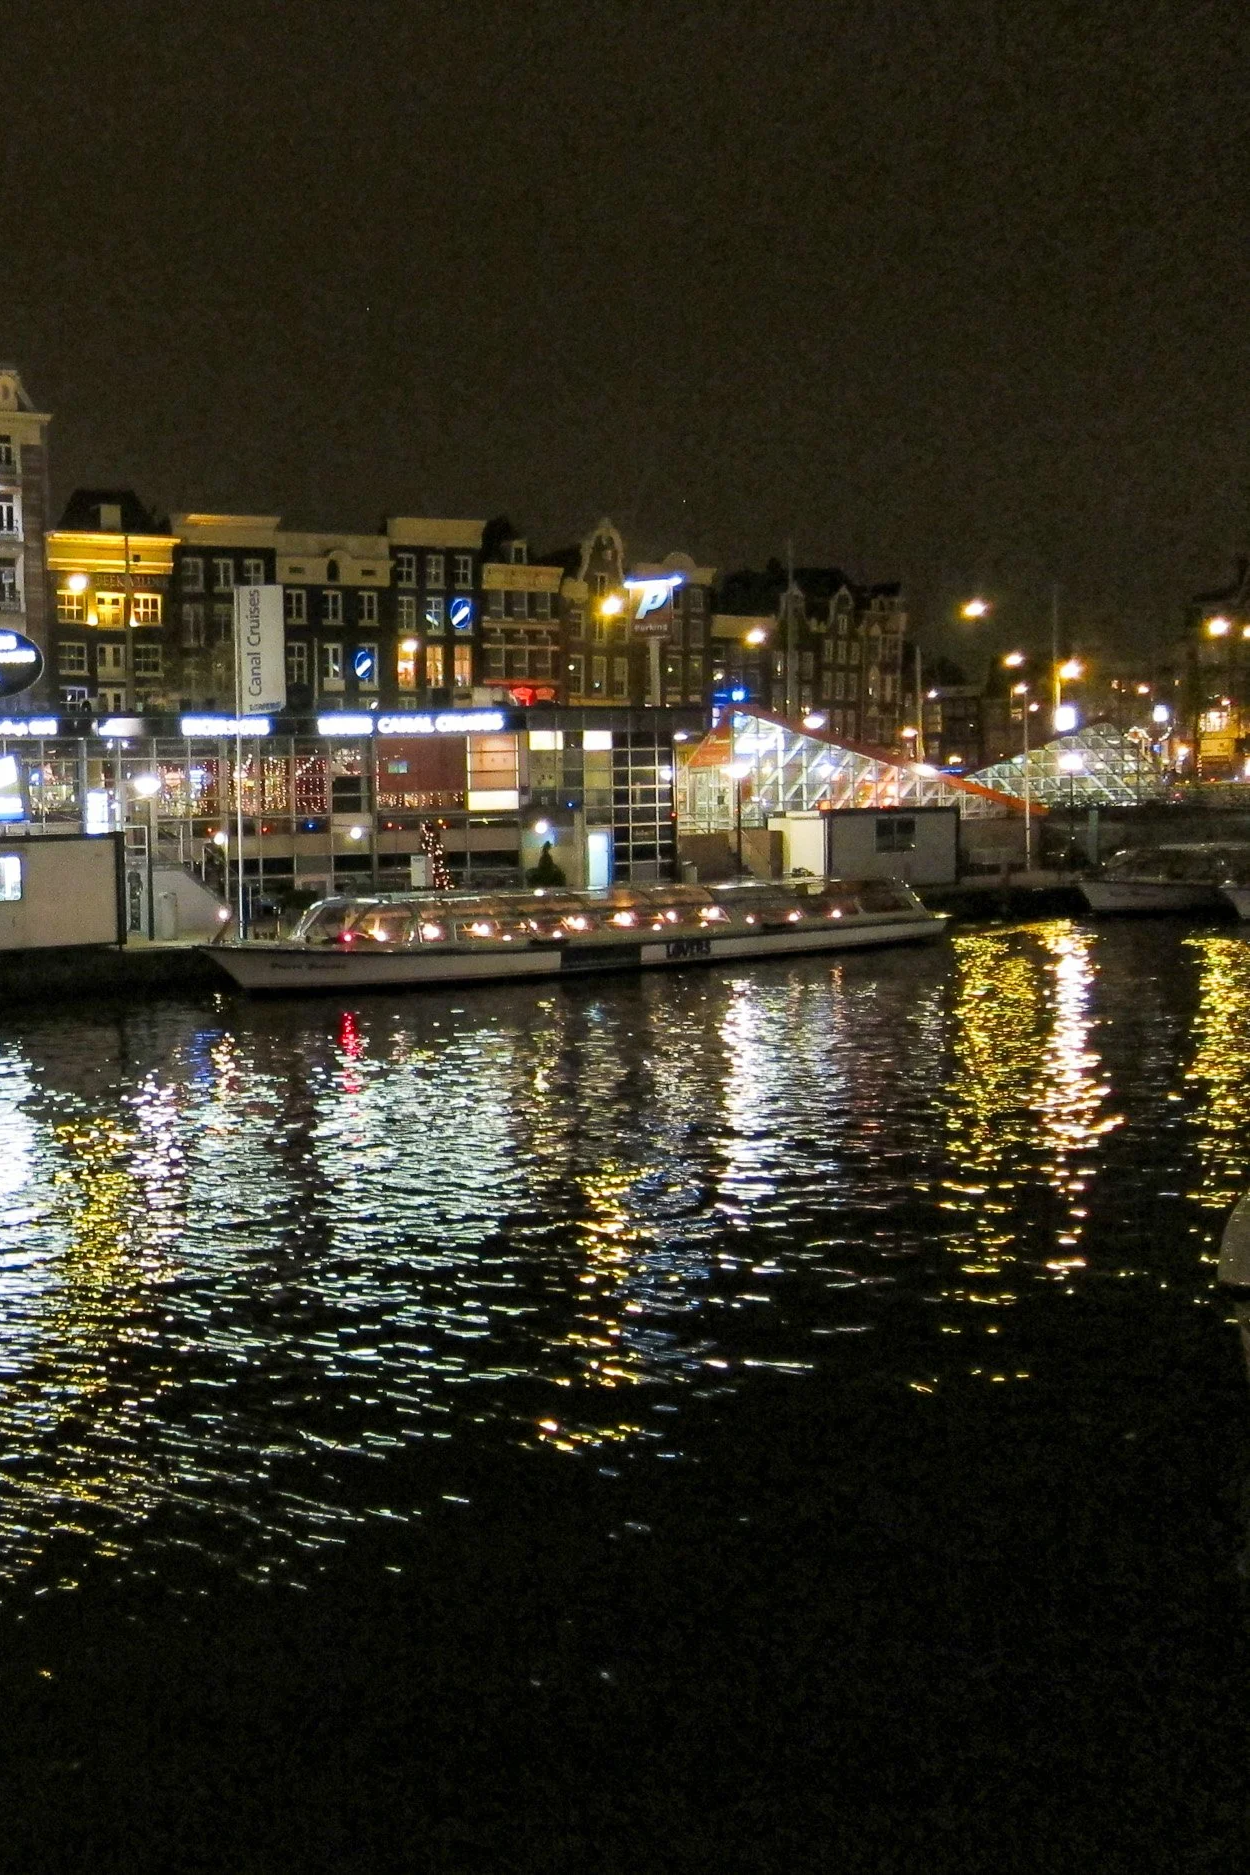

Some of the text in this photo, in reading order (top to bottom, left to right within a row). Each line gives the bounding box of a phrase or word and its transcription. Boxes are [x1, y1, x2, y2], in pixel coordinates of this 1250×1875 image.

[635, 582, 668, 619] P
[246, 589, 262, 697] Canal Cruises
[377, 717, 435, 734] CANAL
